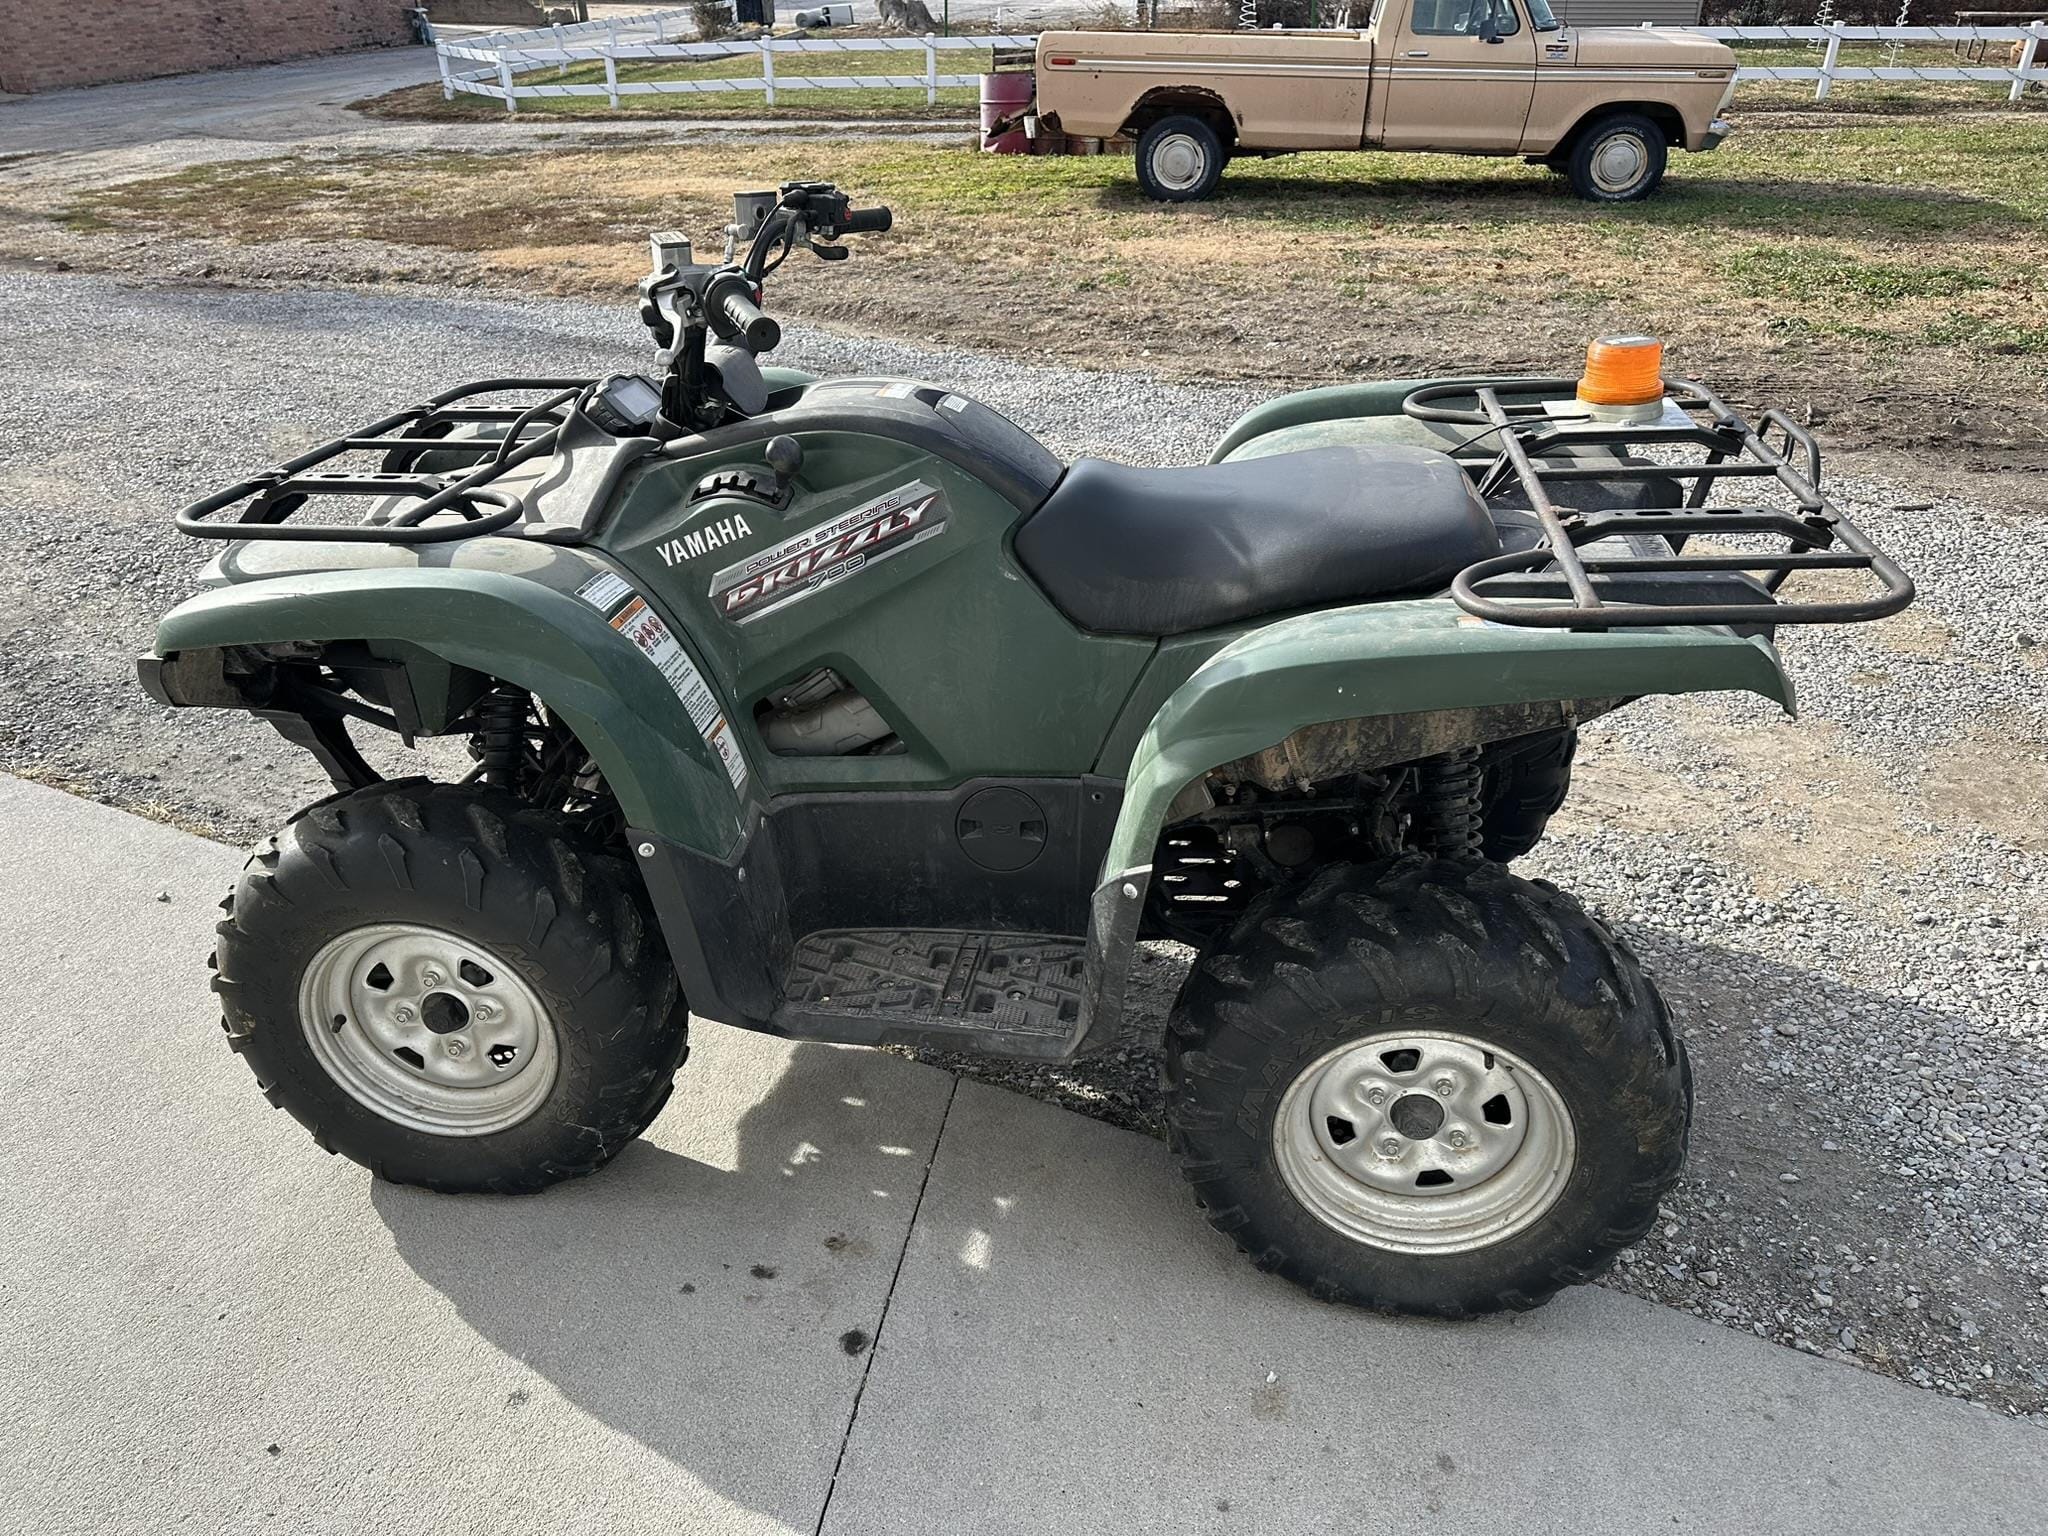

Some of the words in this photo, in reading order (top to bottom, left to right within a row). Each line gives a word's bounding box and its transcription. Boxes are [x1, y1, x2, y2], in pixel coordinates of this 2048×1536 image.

[655, 513, 753, 567] YAMAHA
[726, 496, 938, 611] GRIZZLY
[746, 537, 812, 575] POWER
[815, 495, 900, 543] STEERING
[808, 552, 868, 592] 700
[1235, 1004, 1443, 1142] MAXXIS
